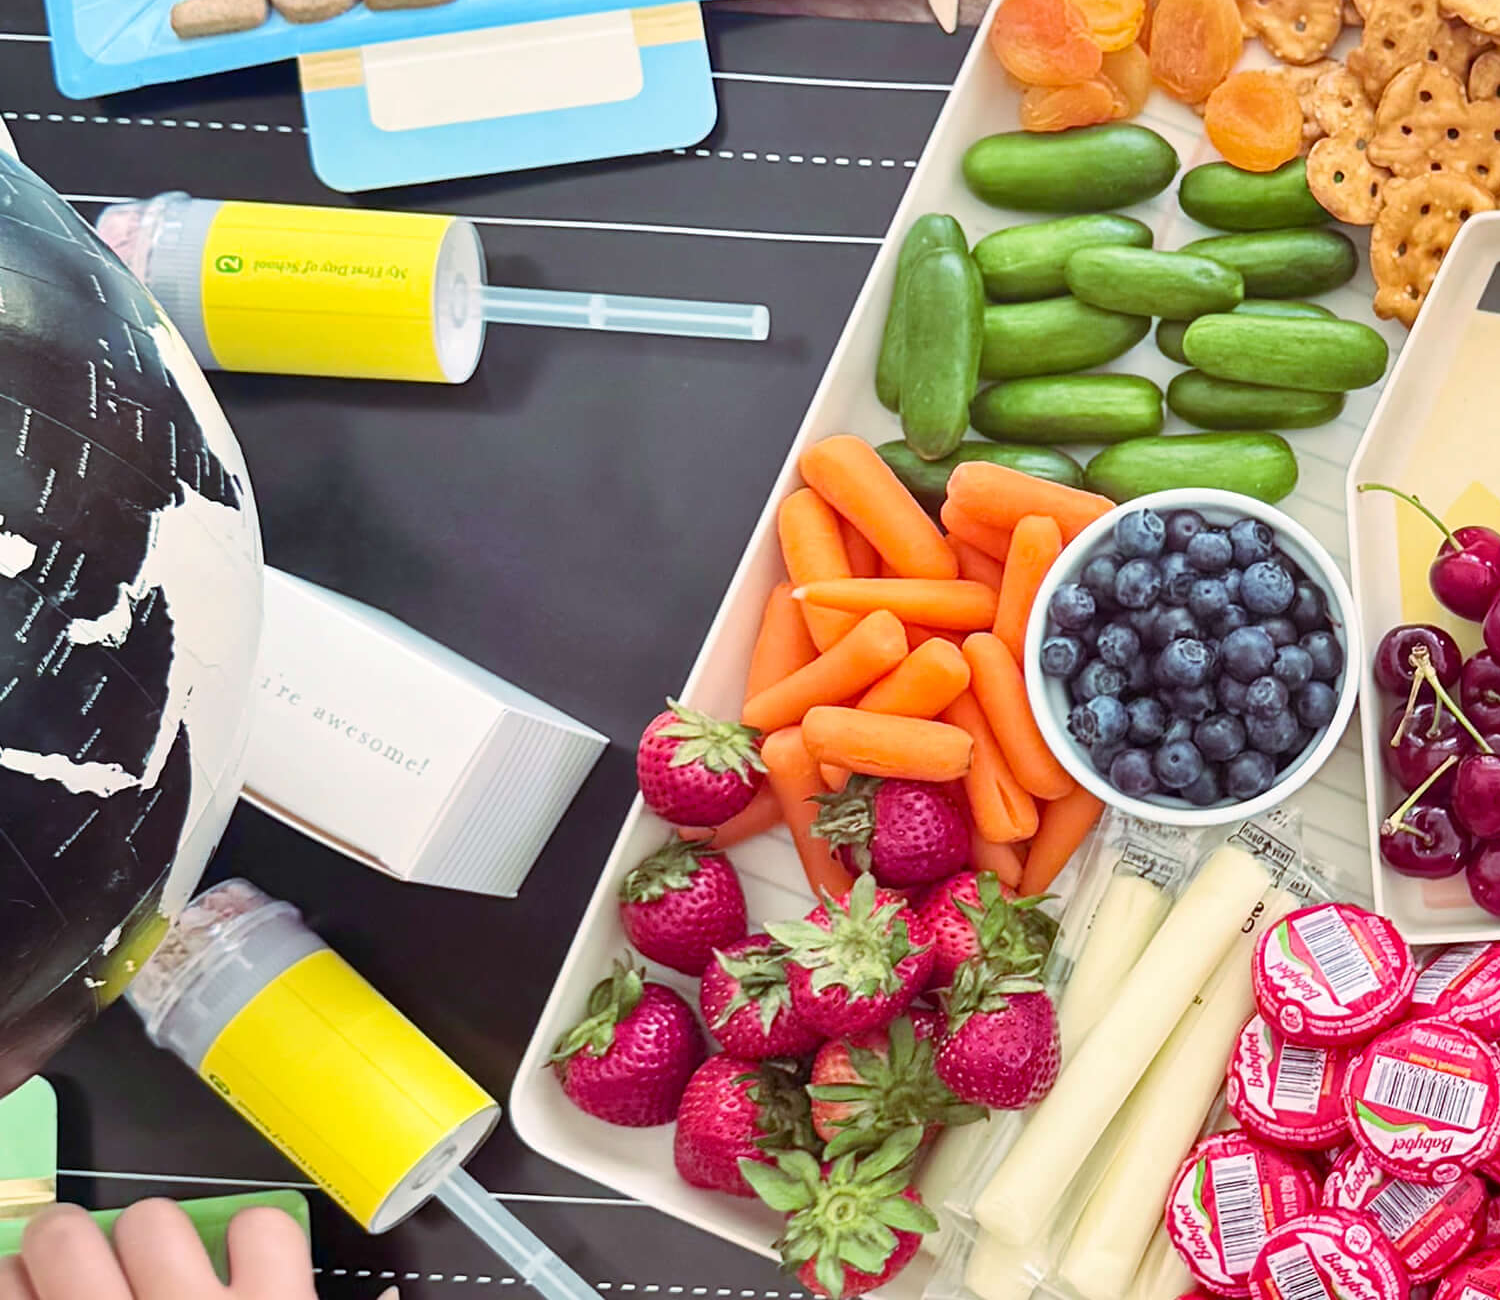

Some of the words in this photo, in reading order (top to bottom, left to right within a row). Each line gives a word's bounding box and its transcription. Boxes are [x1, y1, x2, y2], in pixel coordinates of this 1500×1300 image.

[253, 260, 299, 275] School
[301, 260, 318, 275] of
[321, 261, 348, 277] Day
[351, 264, 383, 279] First
[312, 706, 431, 776] awesome!
[1270, 959, 1322, 999] Babybel
[1247, 1034, 1264, 1087] Babybel
[1391, 1132, 1453, 1154] Babybel
[1178, 1205, 1211, 1260] Babybel
